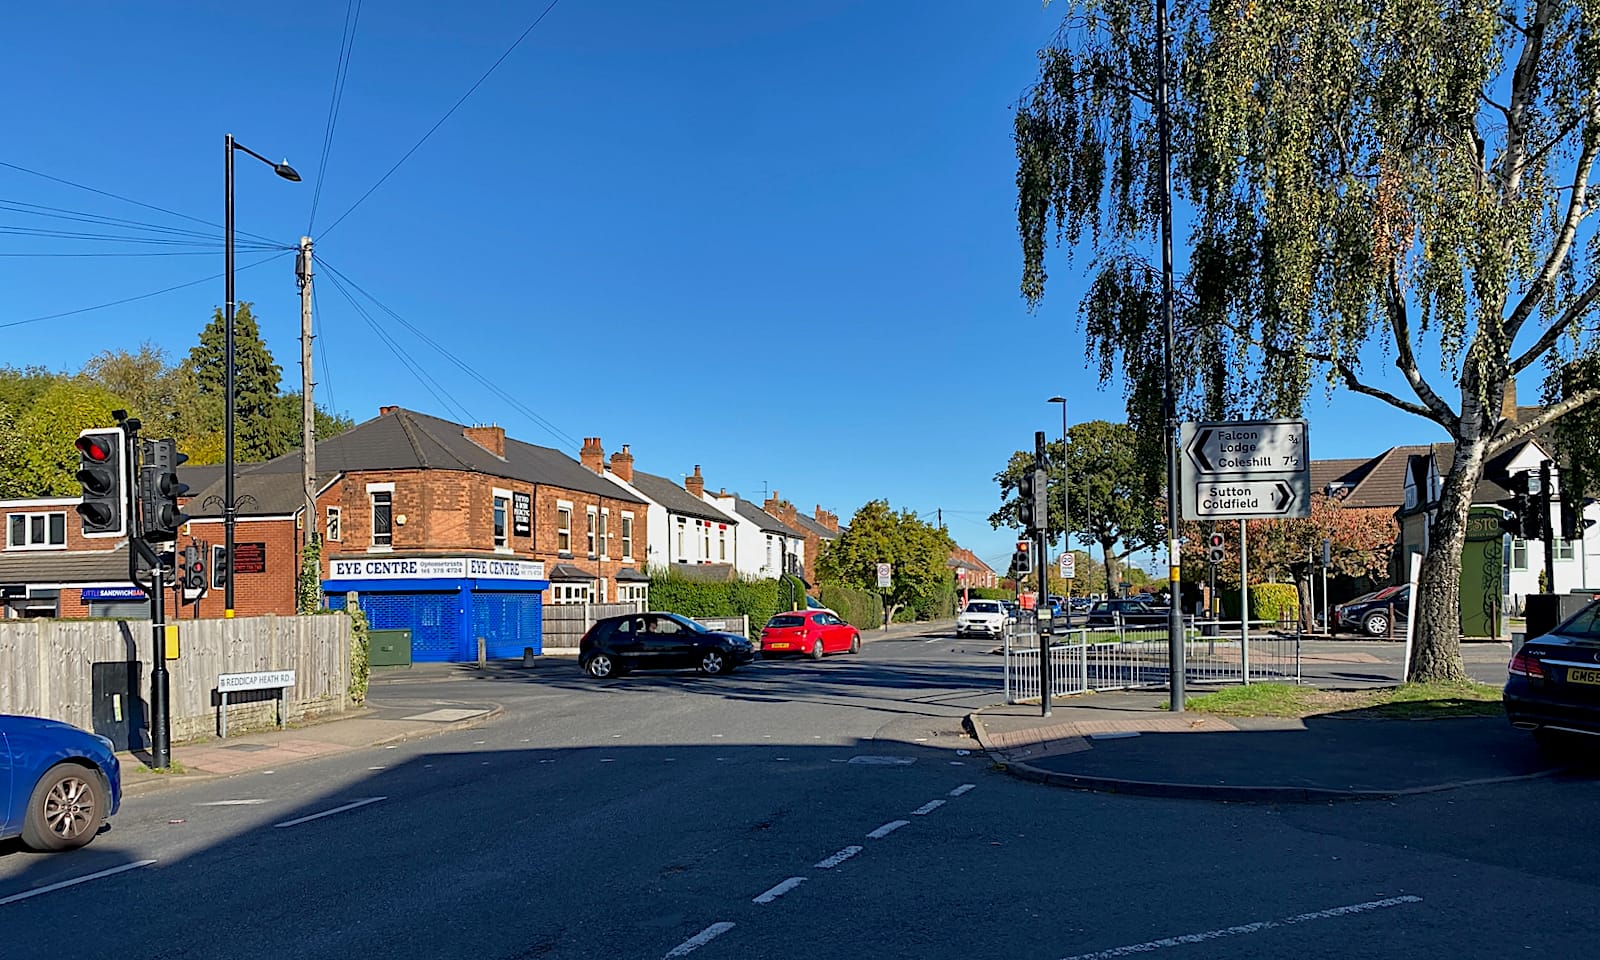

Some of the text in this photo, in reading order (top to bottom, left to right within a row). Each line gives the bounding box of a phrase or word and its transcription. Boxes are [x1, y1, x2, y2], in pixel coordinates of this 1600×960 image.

[1218, 431, 1258, 441] Falcon
[1220, 443, 1257, 453] Lodge
[1218, 456, 1272, 468] Coleshill
[1209, 487, 1252, 497] Sutton
[1270, 492, 1275, 501] 1
[1202, 498, 1258, 509] Coldfield
[336, 561, 417, 575] EYE CENTRE
[471, 560, 487, 574] EYE
[489, 561, 520, 576] CENTRE
[226, 676, 258, 687] REDDICAP
[259, 674, 279, 684] HEATH
